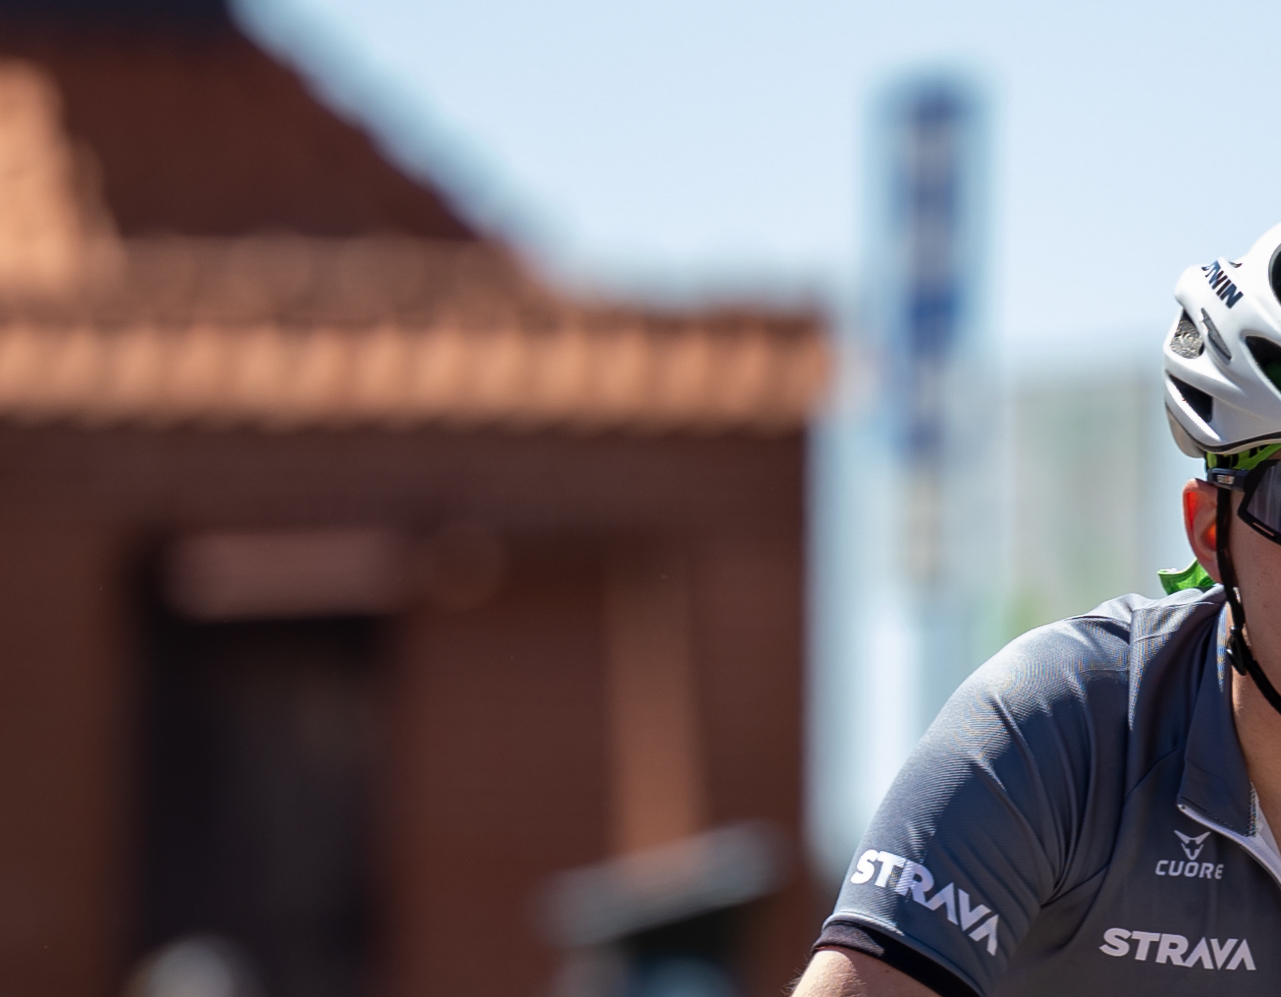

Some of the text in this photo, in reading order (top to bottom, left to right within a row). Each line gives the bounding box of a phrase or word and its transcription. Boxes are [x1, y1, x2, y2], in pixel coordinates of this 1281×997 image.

[1154, 859, 1225, 880] CUORE
[850, 849, 999, 957] STRAVA
[1099, 927, 1257, 971] STRAVA
